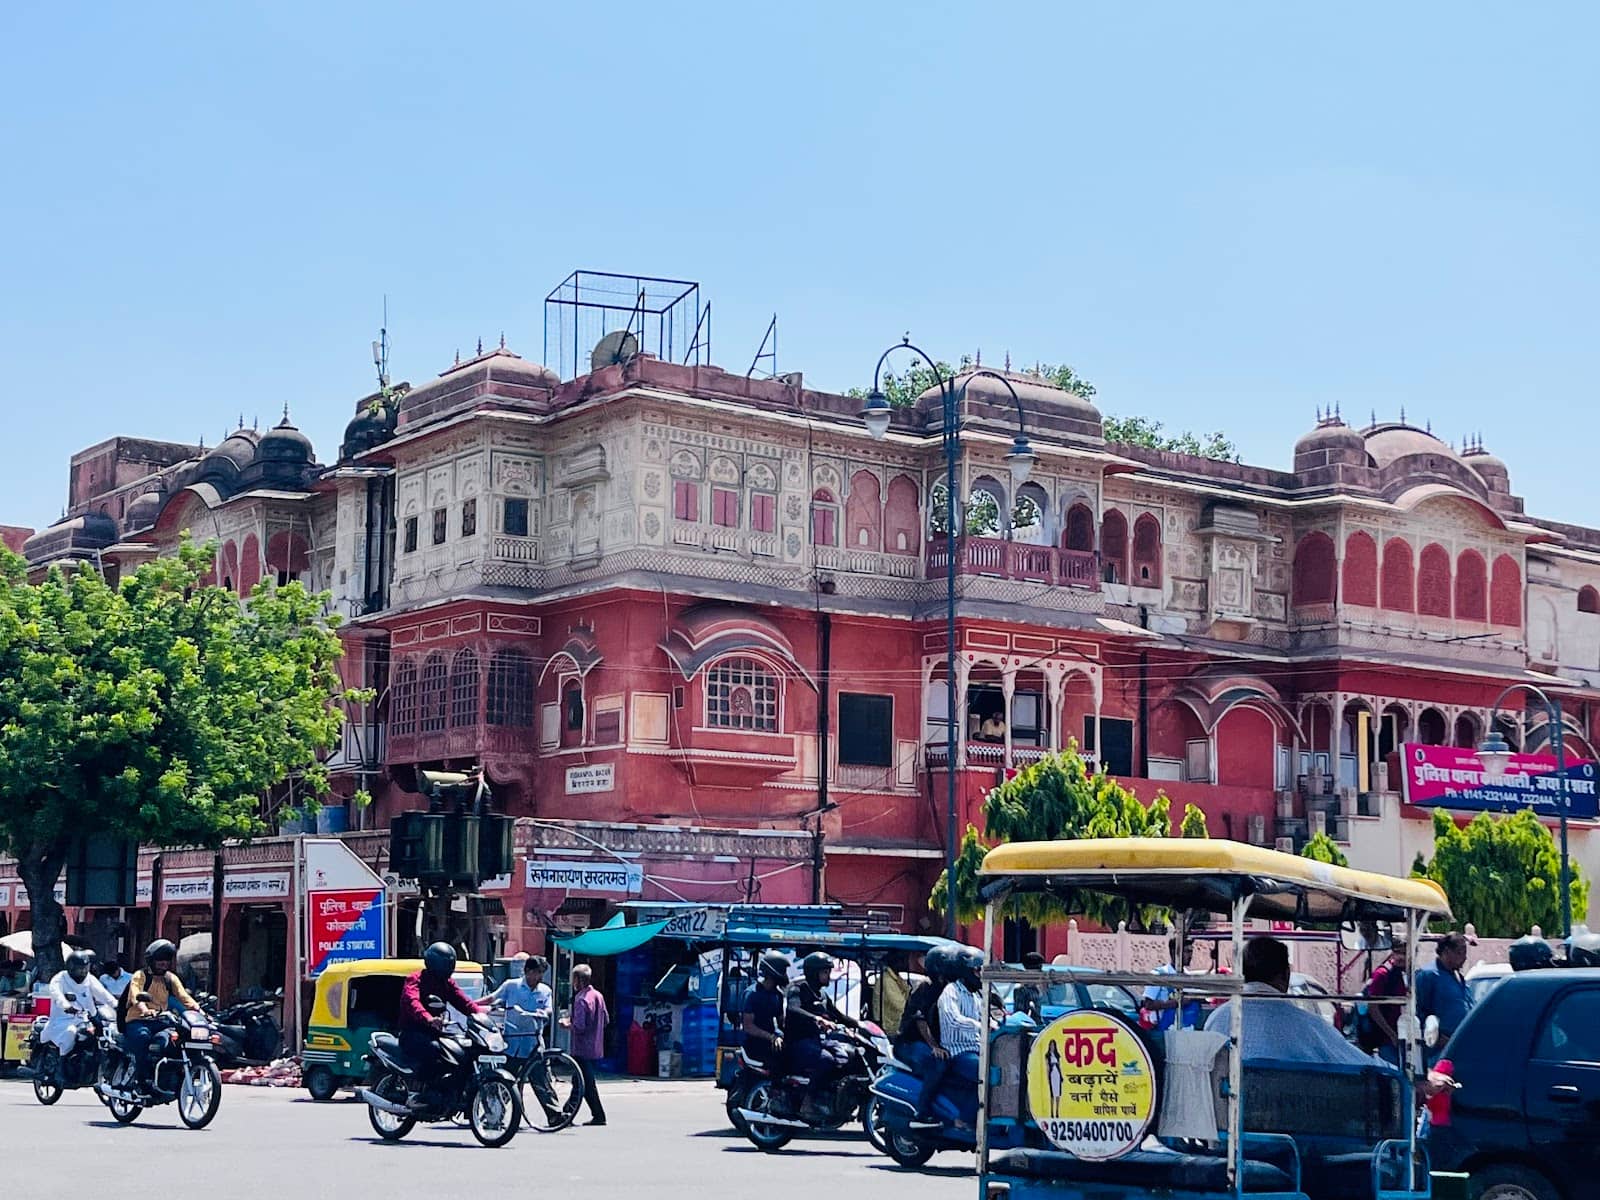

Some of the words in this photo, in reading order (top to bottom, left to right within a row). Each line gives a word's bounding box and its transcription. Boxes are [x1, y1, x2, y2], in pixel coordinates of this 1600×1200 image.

[1414, 762, 1450, 786] पुलिस
[320, 898, 346, 915] पुलिस
[692, 910, 708, 932] 22
[319, 941, 344, 950] POLICE
[1062, 1028, 1118, 1067] कद
[1050, 1121, 1133, 1142] 9250400700
